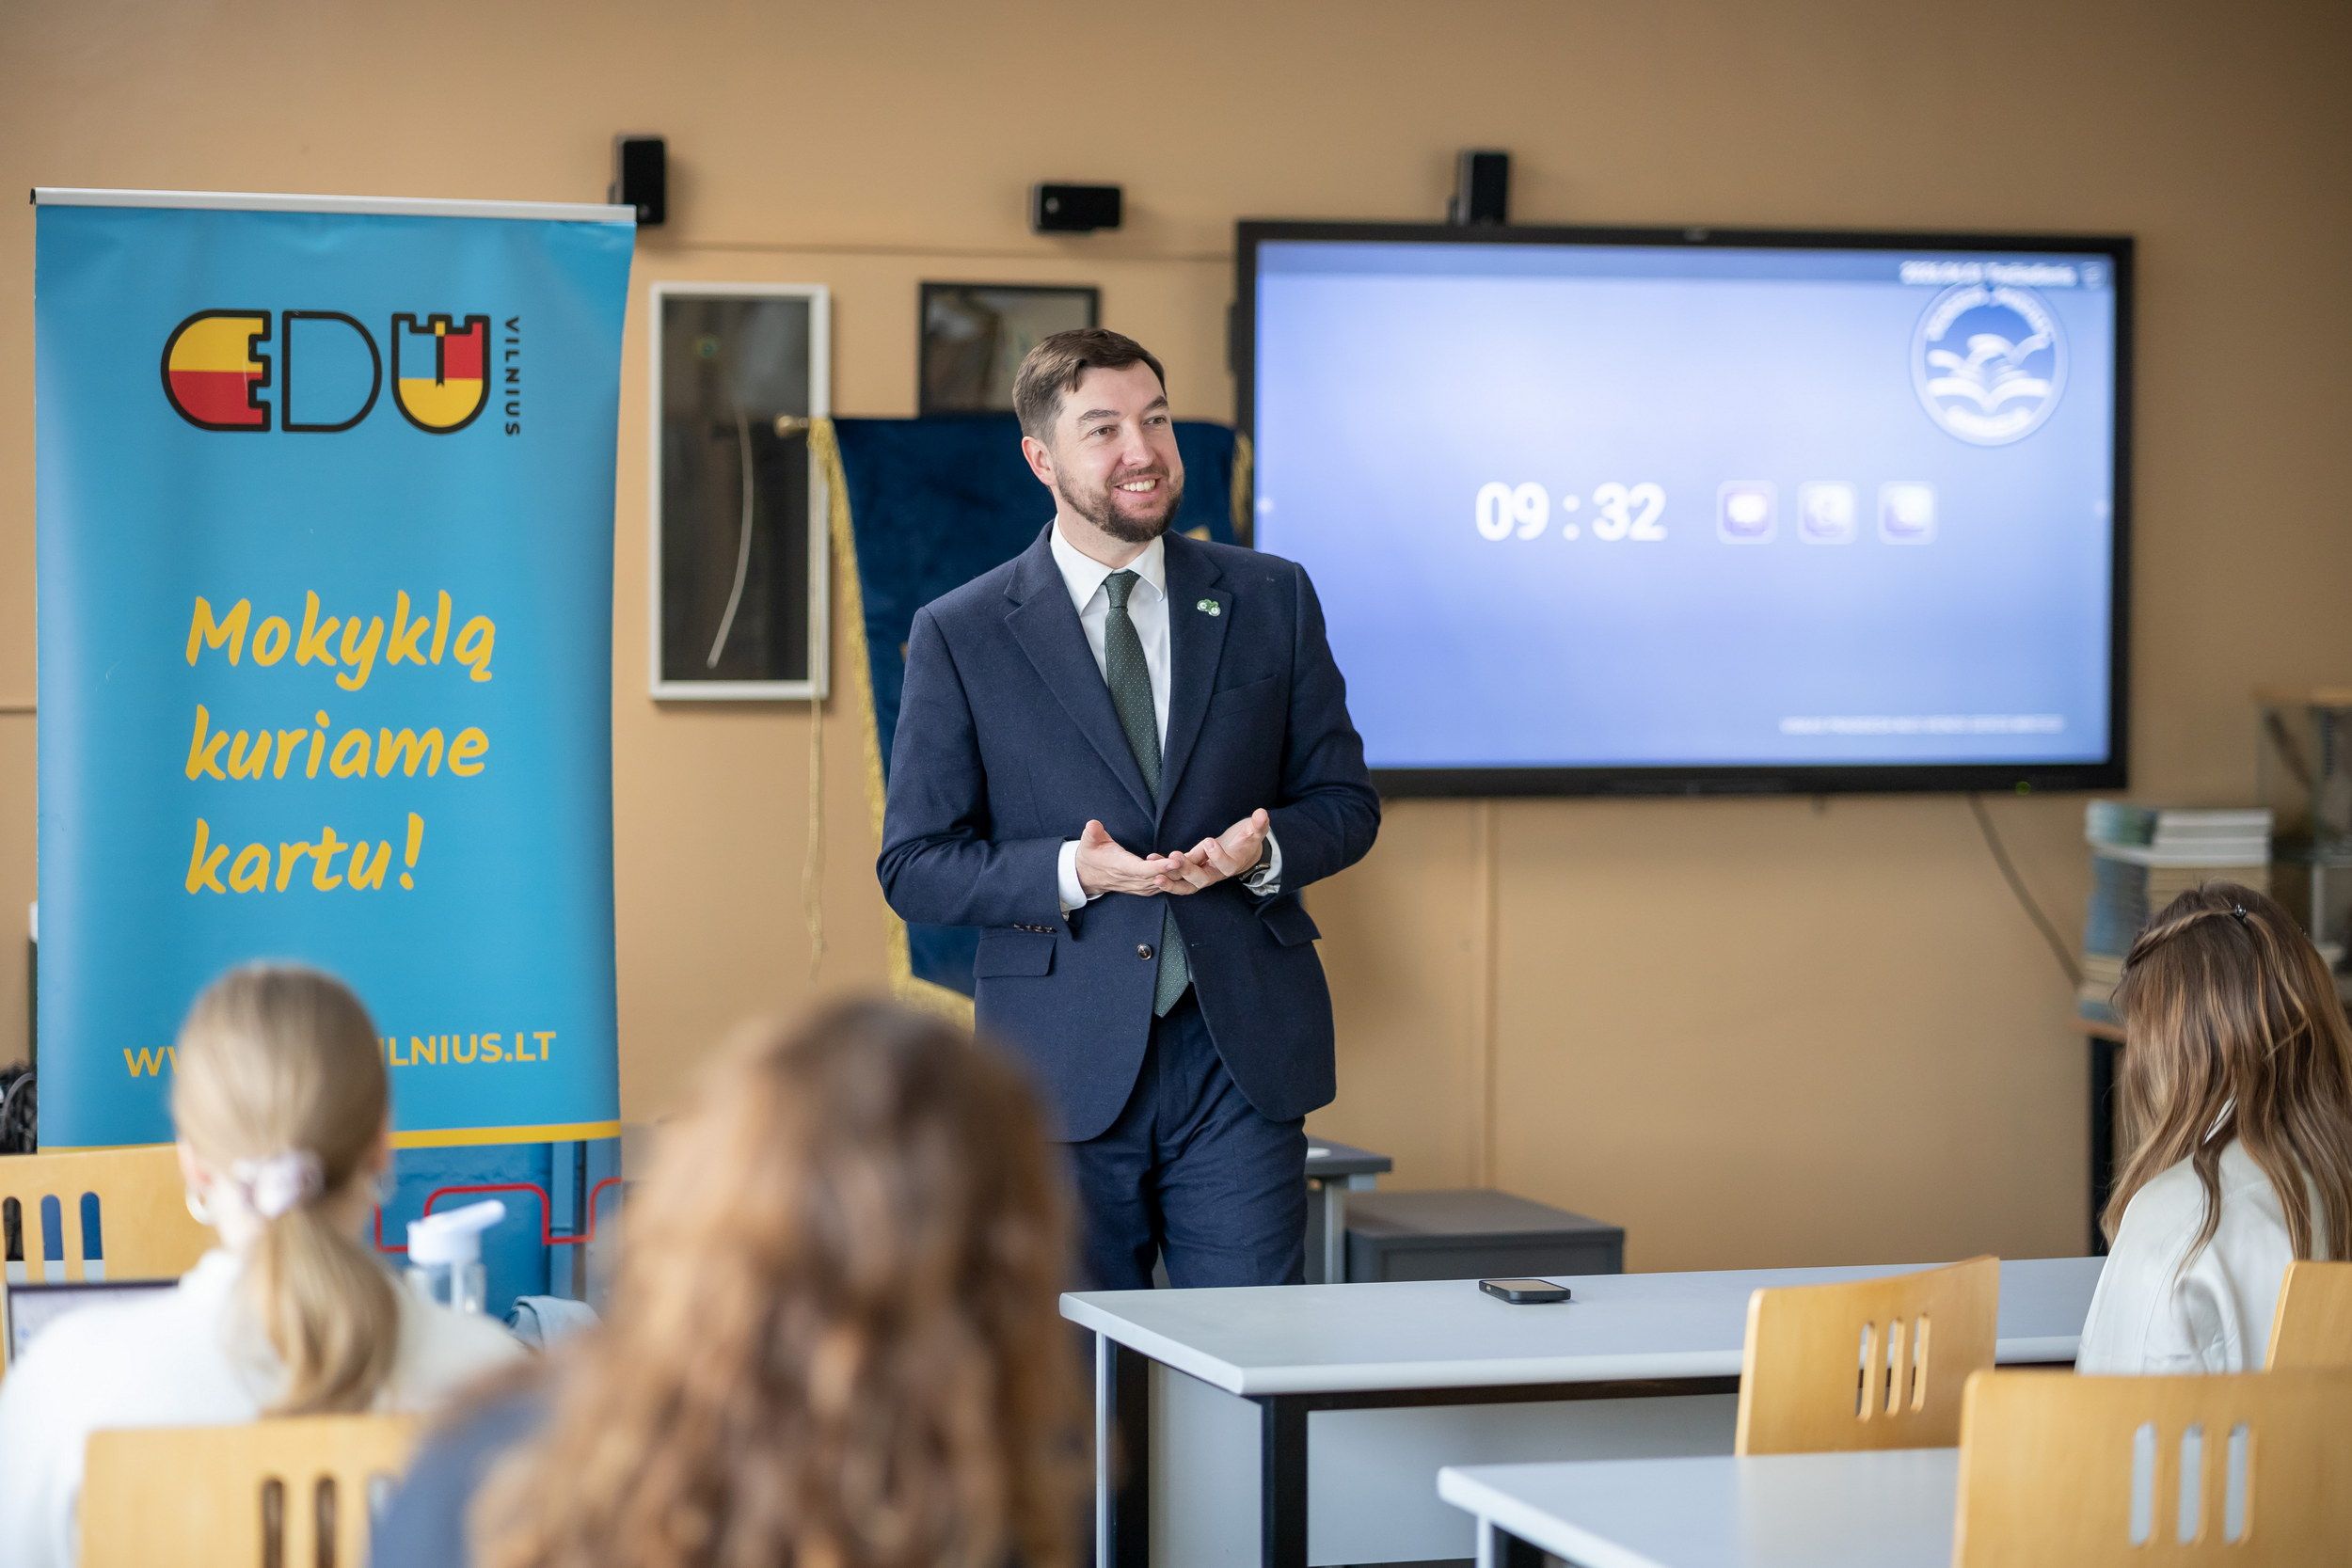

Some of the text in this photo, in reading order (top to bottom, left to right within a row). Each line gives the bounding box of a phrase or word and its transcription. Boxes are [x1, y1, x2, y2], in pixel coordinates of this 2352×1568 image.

[160, 308, 492, 436] EDU
[504, 315, 520, 436] VILNIUS
[185, 589, 496, 691] Mokyklą
[184, 703, 490, 781] kuriame
[184, 811, 425, 895] kartu!
